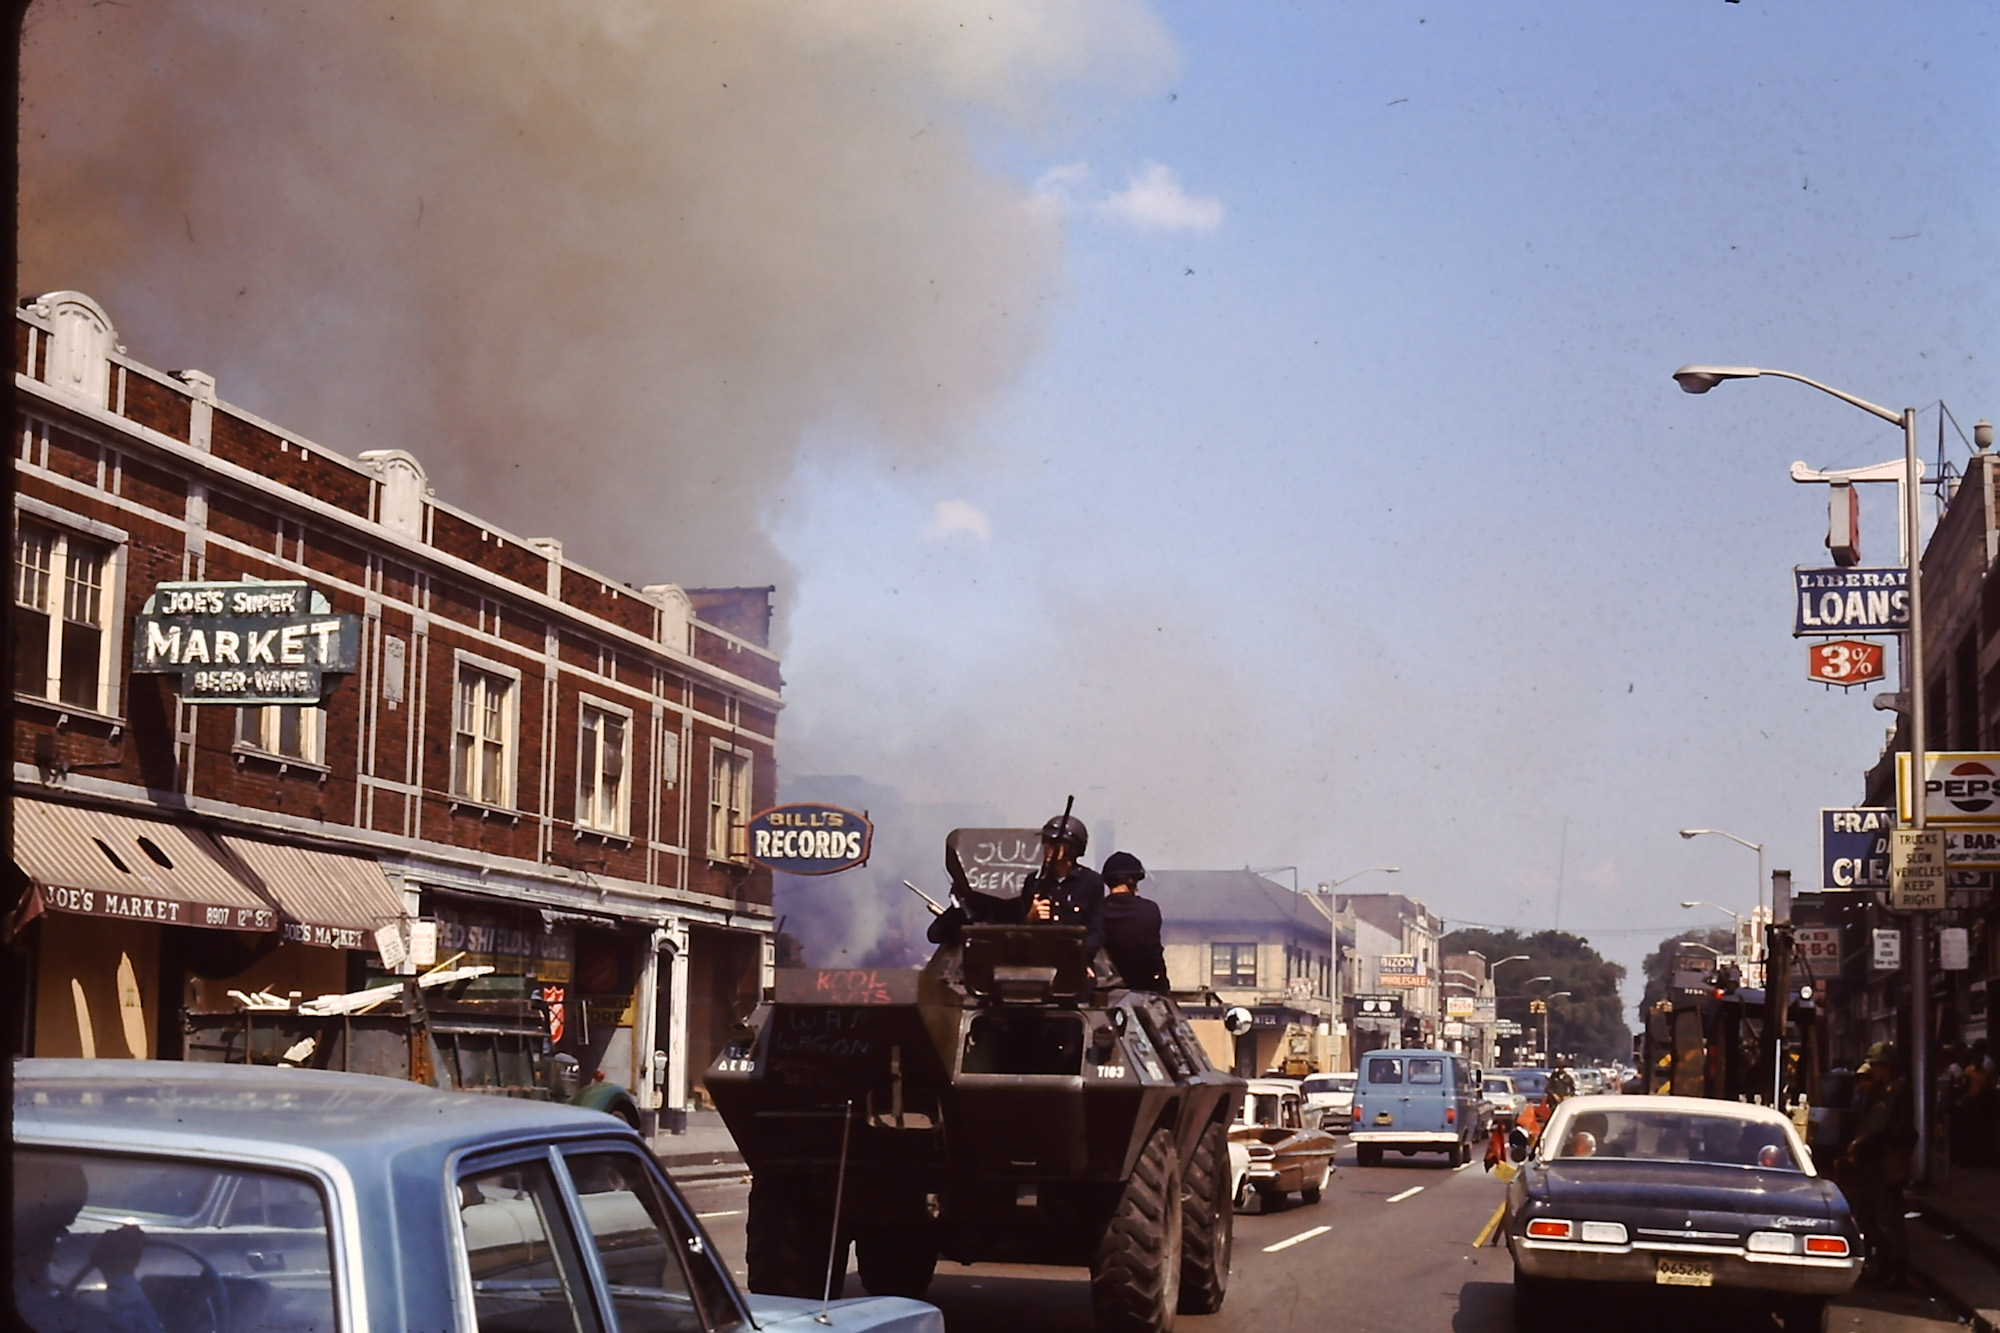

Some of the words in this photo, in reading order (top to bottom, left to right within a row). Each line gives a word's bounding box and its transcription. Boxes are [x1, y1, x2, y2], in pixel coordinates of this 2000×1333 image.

[162, 590, 225, 615] JOE'S
[1802, 590, 1909, 626] LOANS
[146, 620, 340, 664] MARKET
[1821, 645, 1872, 678] 3%
[769, 811, 844, 827] BILL'S
[755, 830, 861, 859] RECORDS
[1899, 834, 1938, 846] TRUCKS
[1906, 853, 1933, 864] SLOW
[1894, 867, 1943, 878] VEHICLES
[1904, 880, 1935, 891] KEEP
[46, 885, 94, 912] JOE'S
[105, 894, 180, 921] MARKET
[206, 906, 230, 925] 8907
[255, 910, 274, 928] ST
[1903, 894, 1936, 906] RIGHT
[283, 921, 312, 943] JOE'S
